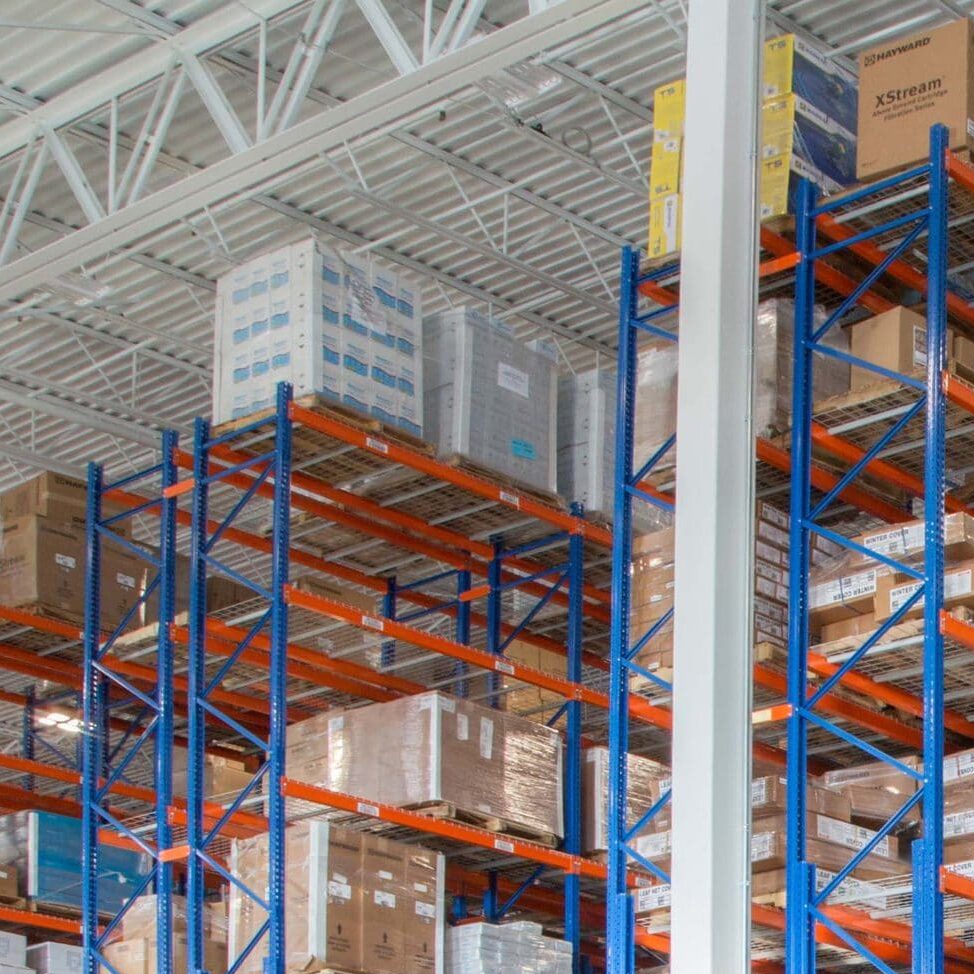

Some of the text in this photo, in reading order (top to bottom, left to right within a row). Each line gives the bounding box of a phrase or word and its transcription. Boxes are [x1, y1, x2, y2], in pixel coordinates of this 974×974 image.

[876, 37, 932, 62] HAYWARD
[875, 77, 942, 108] XStream
[865, 533, 887, 544] WINTER
